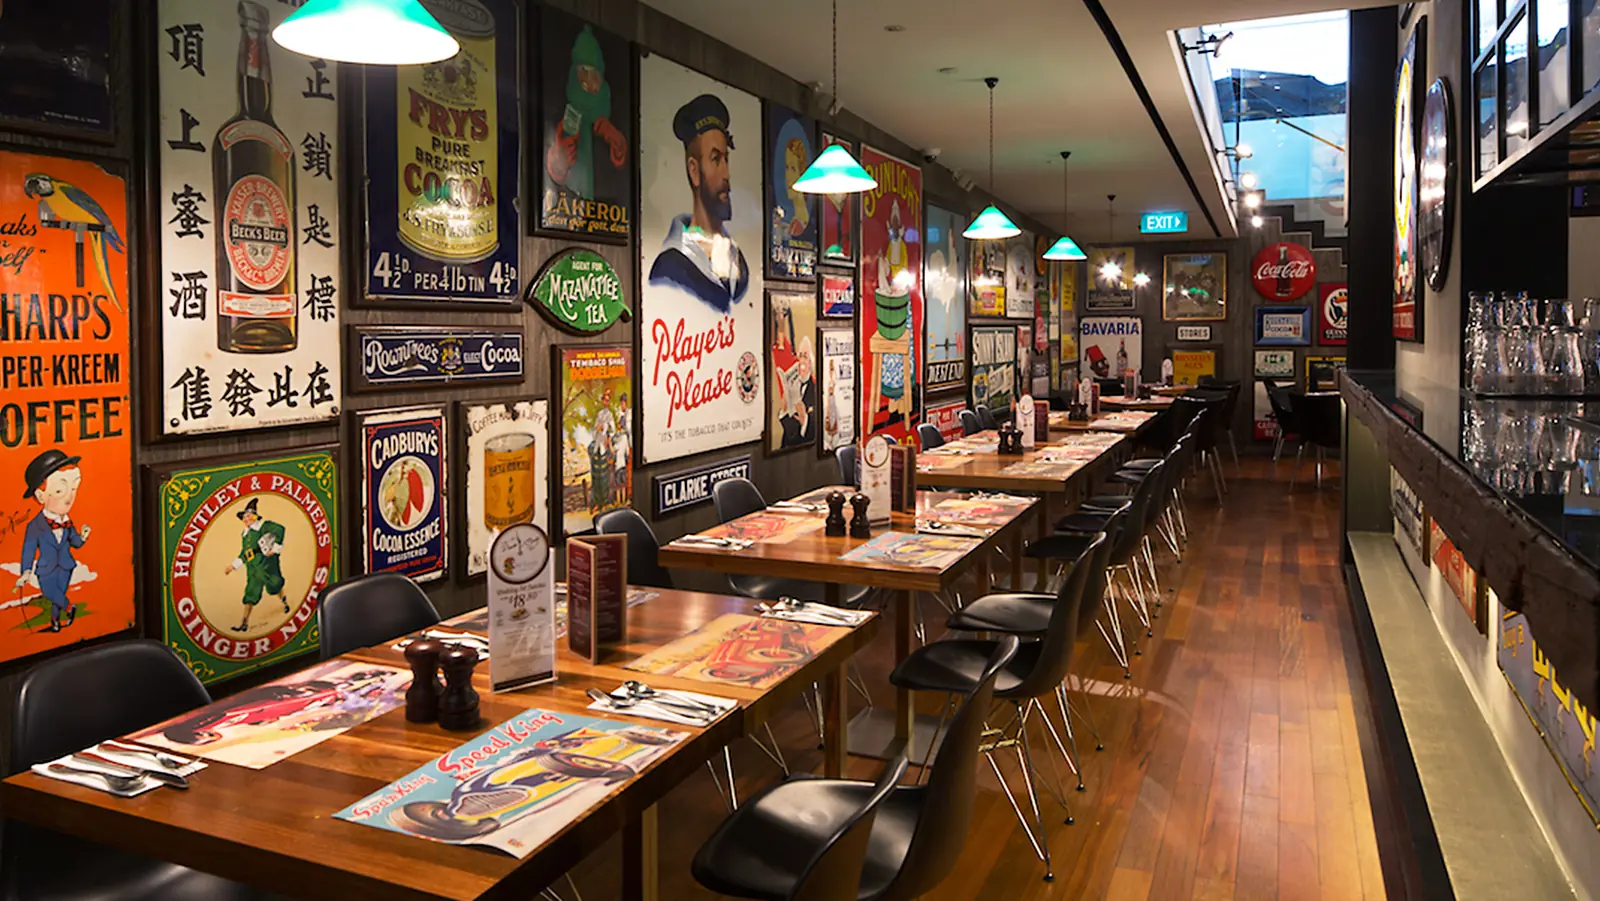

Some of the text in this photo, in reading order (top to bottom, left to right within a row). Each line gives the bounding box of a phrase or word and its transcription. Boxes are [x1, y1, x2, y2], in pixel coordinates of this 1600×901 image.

[408, 86, 489, 141] FRY'S
[415, 146, 485, 177] BREAKFAST
[432, 136, 470, 158] PURE
[231, 181, 286, 222] KAISER BREWERY
[404, 163, 495, 210] COCOA
[863, 161, 920, 230] SUNLIGHT
[0, 213, 37, 236] aks
[232, 223, 286, 242] BECK'S BEER
[1147, 215, 1174, 230] EXIT
[414, 272, 438, 290] PER
[468, 275, 486, 293] TIN
[572, 261, 590, 271] AGENT
[548, 272, 619, 321] MAZAWATTEE
[585, 303, 608, 325] TEA
[0, 293, 111, 341] HARP'S
[1081, 321, 1140, 336] BAVARIA
[1179, 328, 1209, 338] STORES
[366, 339, 440, 376] Rowntree's
[481, 339, 520, 372] Cocoa
[652, 316, 735, 386] Player's
[2, 353, 119, 389] PER-KREEM
[666, 368, 732, 428] Please
[0, 396, 123, 447] OFFEE
[674, 429, 686, 441] THE
[688, 424, 716, 438] TOBACCO
[371, 430, 439, 470] CADBURY'S
[665, 475, 709, 506] CLARKE
[174, 475, 331, 579] HUNTLEY & PALMERS
[373, 516, 441, 552] COCOA ESSENCE
[177, 566, 329, 659] GINGER NUTS
[436, 713, 563, 774] Speed King
